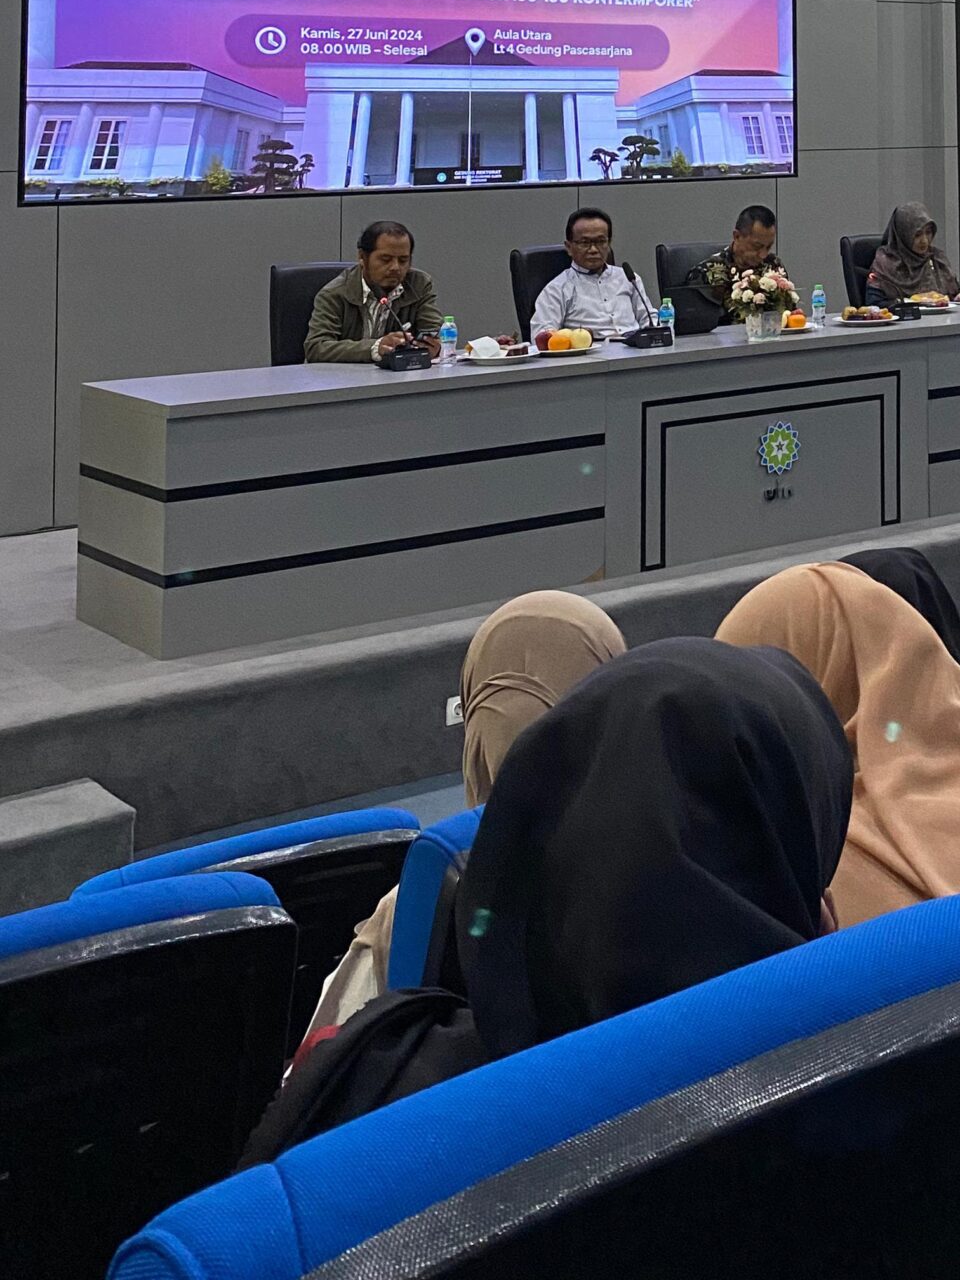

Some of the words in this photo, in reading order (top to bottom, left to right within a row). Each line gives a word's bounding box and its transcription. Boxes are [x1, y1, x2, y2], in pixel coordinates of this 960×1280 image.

[300, 27, 345, 40] Kamis,
[347, 28, 363, 40] 27
[364, 29, 389, 40] Juni
[390, 29, 423, 41] 2024
[493, 29, 520, 40] Aula
[521, 29, 552, 41] Utara
[300, 42, 343, 55] 08.00
[344, 43, 372, 55] WIB
[383, 44, 428, 56] Selesai
[515, 44, 562, 57] Gedung
[563, 45, 633, 58] Pascasarjana
